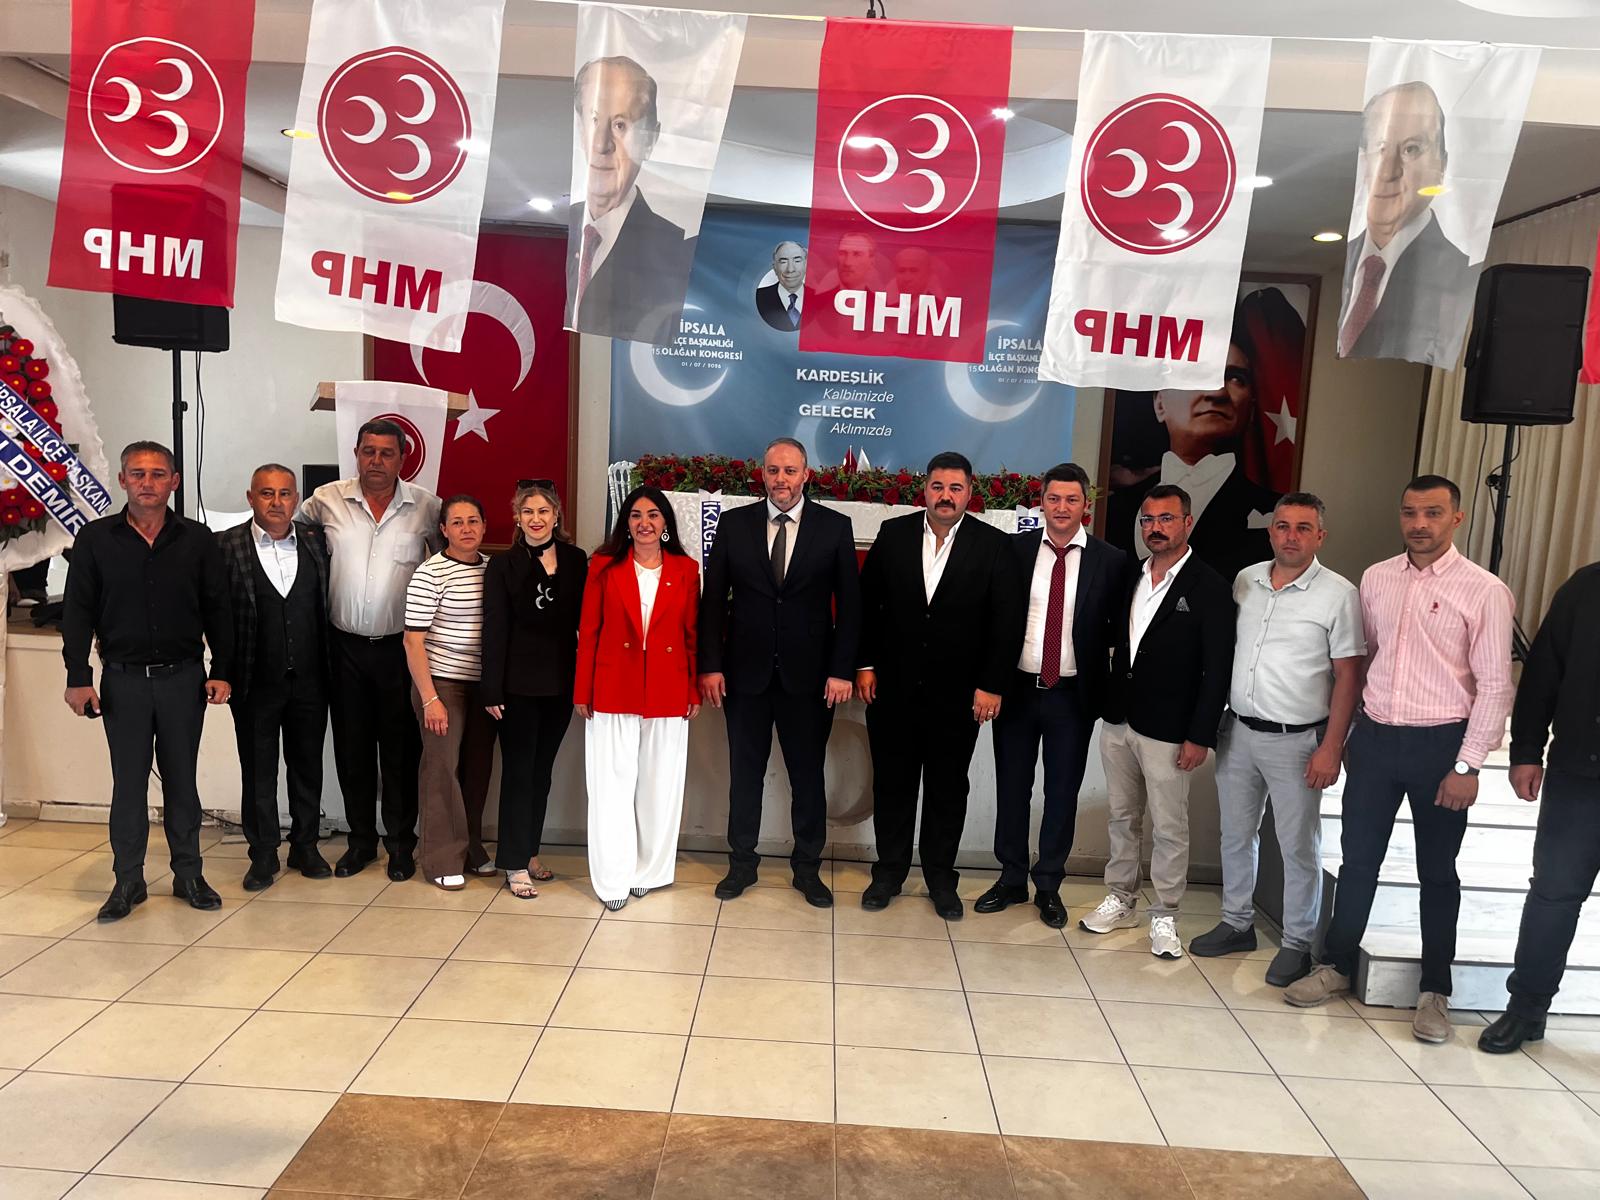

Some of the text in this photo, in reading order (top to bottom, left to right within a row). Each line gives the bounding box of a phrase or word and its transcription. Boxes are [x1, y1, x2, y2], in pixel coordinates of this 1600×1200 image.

[680, 318, 726, 336] İPSALA
[673, 336, 734, 349] LÇE BAŞKANLIĞI
[997, 335, 1043, 351] İPSALA
[698, 349, 743, 361] KONGRESİ
[988, 351, 1006, 363] İLÇE
[796, 368, 885, 385] KARDEŞLİK
[823, 387, 895, 403] Kalbimizde
[799, 403, 876, 420] GELECEK
[830, 422, 892, 437] Aklımızda
